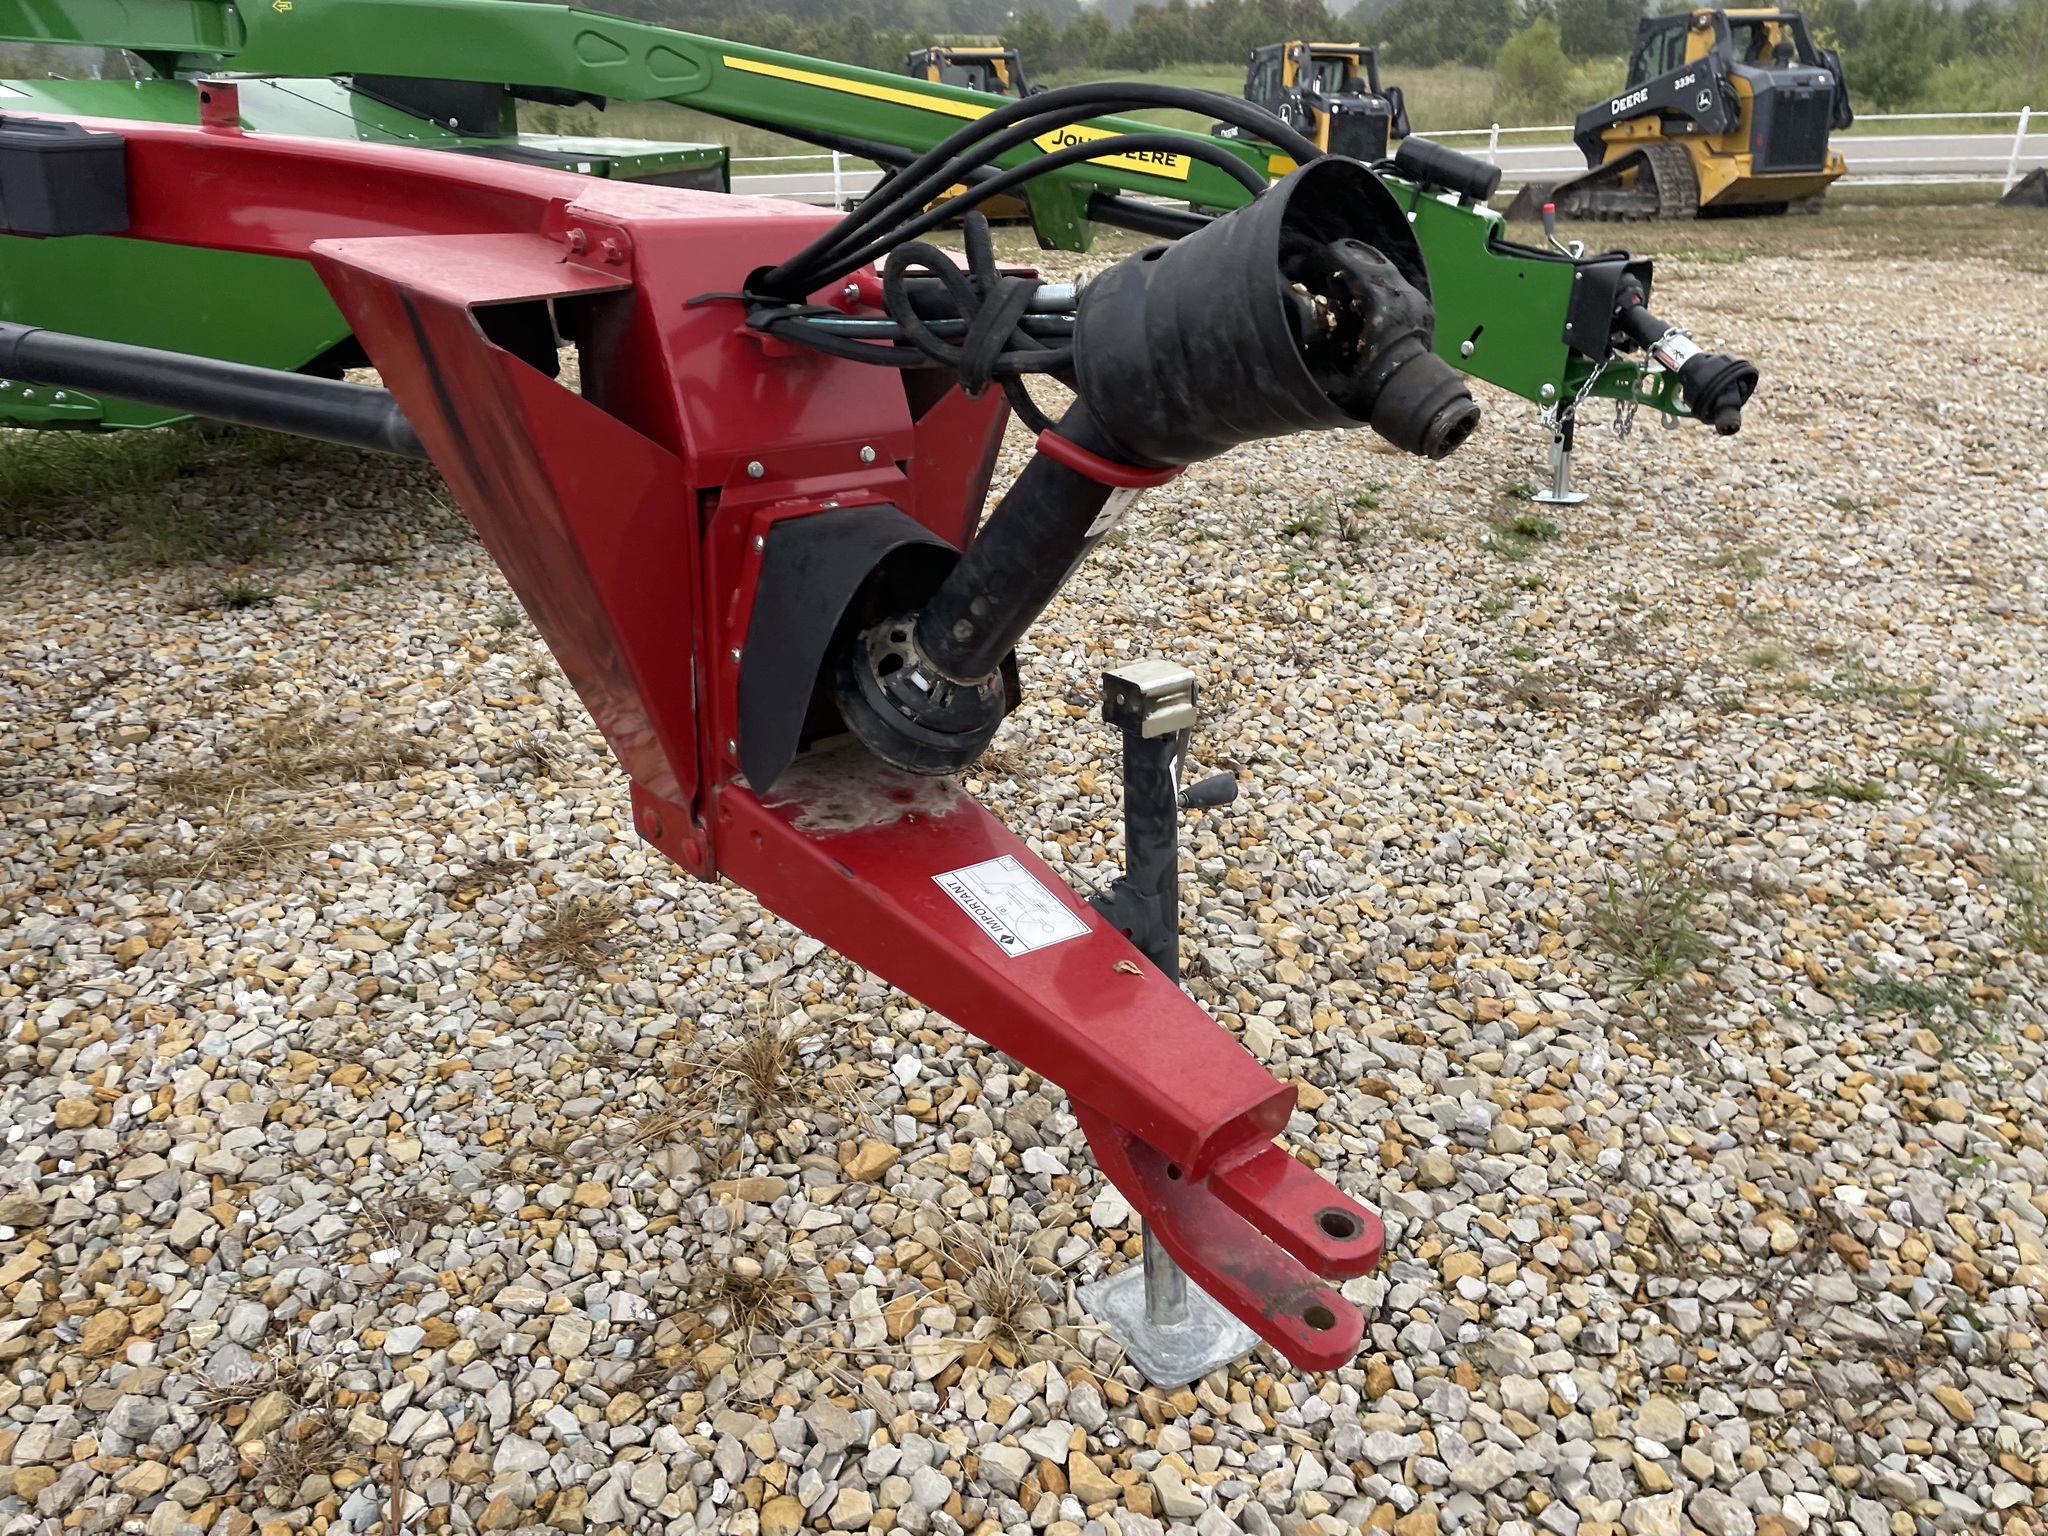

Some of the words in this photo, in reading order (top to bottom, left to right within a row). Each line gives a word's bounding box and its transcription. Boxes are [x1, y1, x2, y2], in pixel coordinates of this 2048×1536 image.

[1674, 73, 1695, 91] 333G
[1611, 87, 1648, 115] DEERE
[1051, 129, 1092, 147] JO
[1114, 148, 1178, 167] EERE
[946, 881, 1004, 932] IMPORTANT
